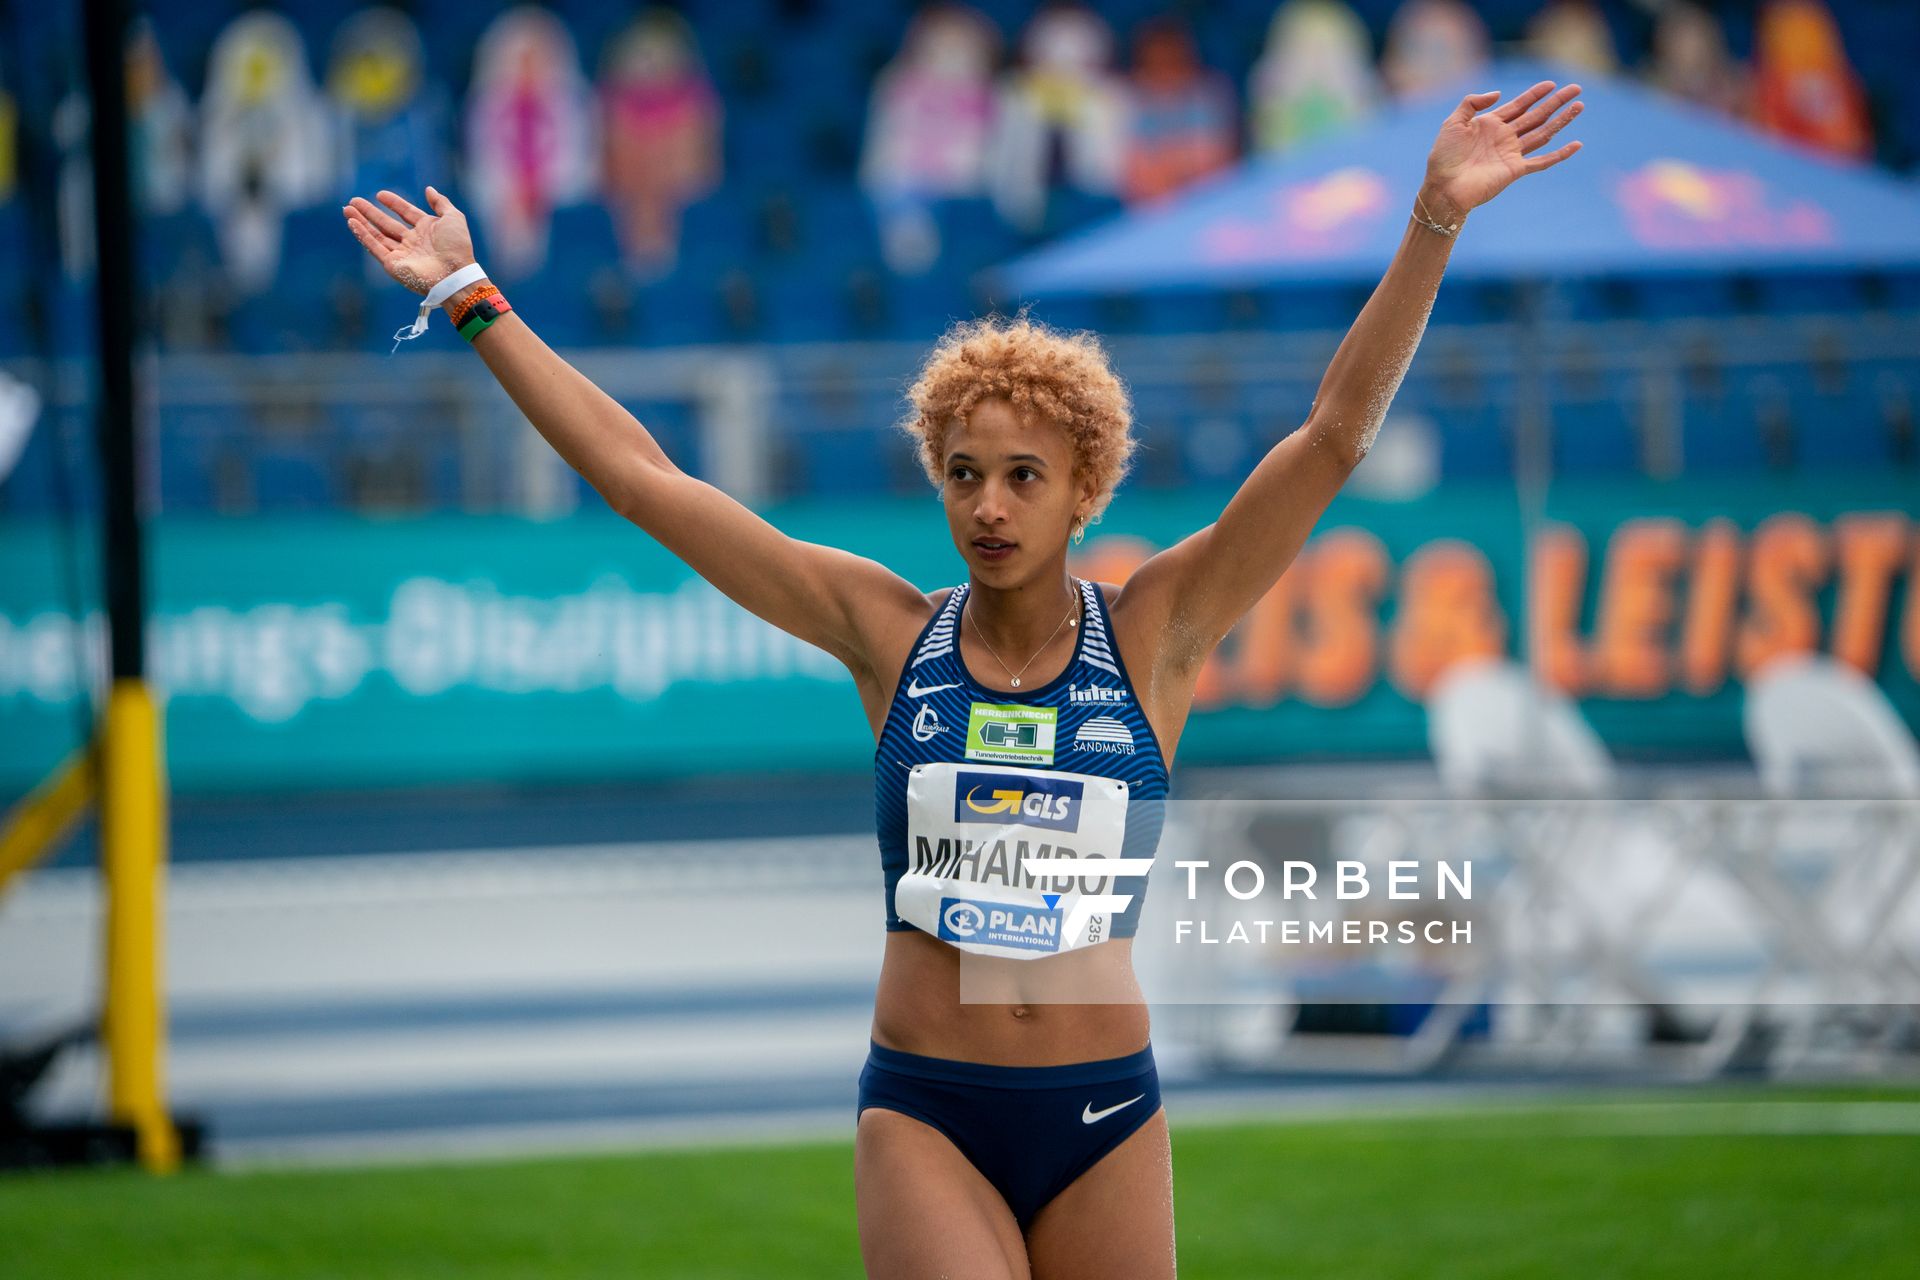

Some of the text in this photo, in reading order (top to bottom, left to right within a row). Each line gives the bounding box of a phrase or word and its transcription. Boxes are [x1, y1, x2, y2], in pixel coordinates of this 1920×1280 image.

[974, 708, 1054, 720] HERRENKNECHT
[975, 750, 1044, 762] Tunnelvortriebstechnik
[1073, 740, 1136, 755] SANDMASTER
[1022, 792, 1071, 821] GLS
[912, 835, 1109, 896] MIHAMBO
[989, 910, 1057, 937] PLAN
[1088, 914, 1103, 943] 235
[988, 933, 1055, 947] INTERNATIONAL
